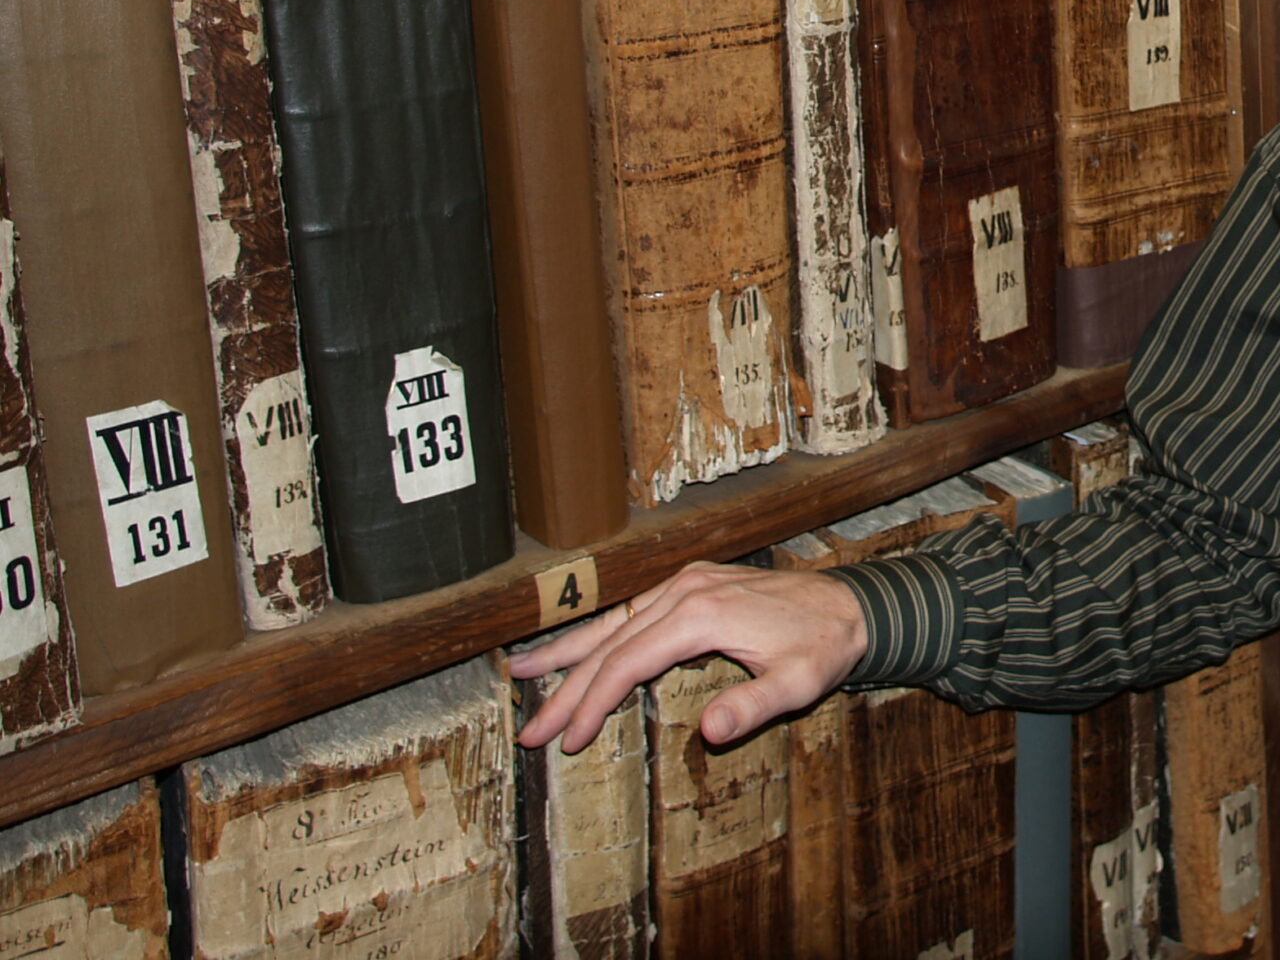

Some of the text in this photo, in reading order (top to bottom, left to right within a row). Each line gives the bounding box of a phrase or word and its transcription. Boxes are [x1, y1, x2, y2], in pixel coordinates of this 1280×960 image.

[980, 210, 1013, 250] VIII
[395, 369, 450, 411] VIII
[246, 397, 303, 447] VIII
[396, 413, 465, 475] 133
[96, 411, 194, 507] VIII
[127, 509, 191, 566] 131
[557, 572, 583, 610] 4
